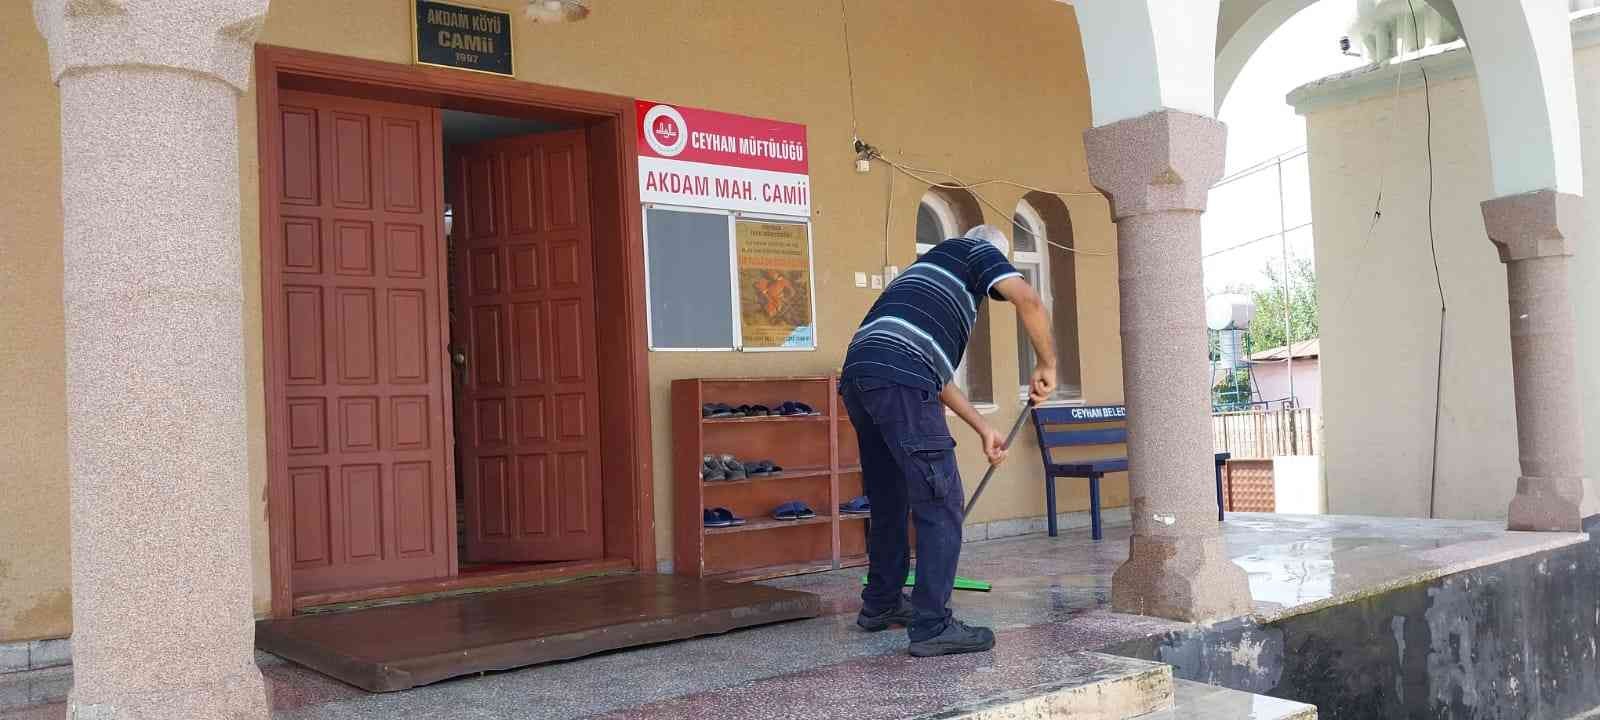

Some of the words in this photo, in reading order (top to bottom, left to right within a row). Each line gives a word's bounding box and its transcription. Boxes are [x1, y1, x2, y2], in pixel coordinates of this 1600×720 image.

[427, 9, 470, 29] AKDAM
[472, 14, 501, 34] KÖYÜ
[691, 131, 737, 153] CEYHAN
[739, 136, 803, 162] MÜFTÜLÜĞÜ
[646, 170, 709, 197] AKDAM
[715, 177, 758, 201] MAH.
[762, 181, 807, 206] CAMİİ
[1071, 407, 1103, 419] CEYHAN
